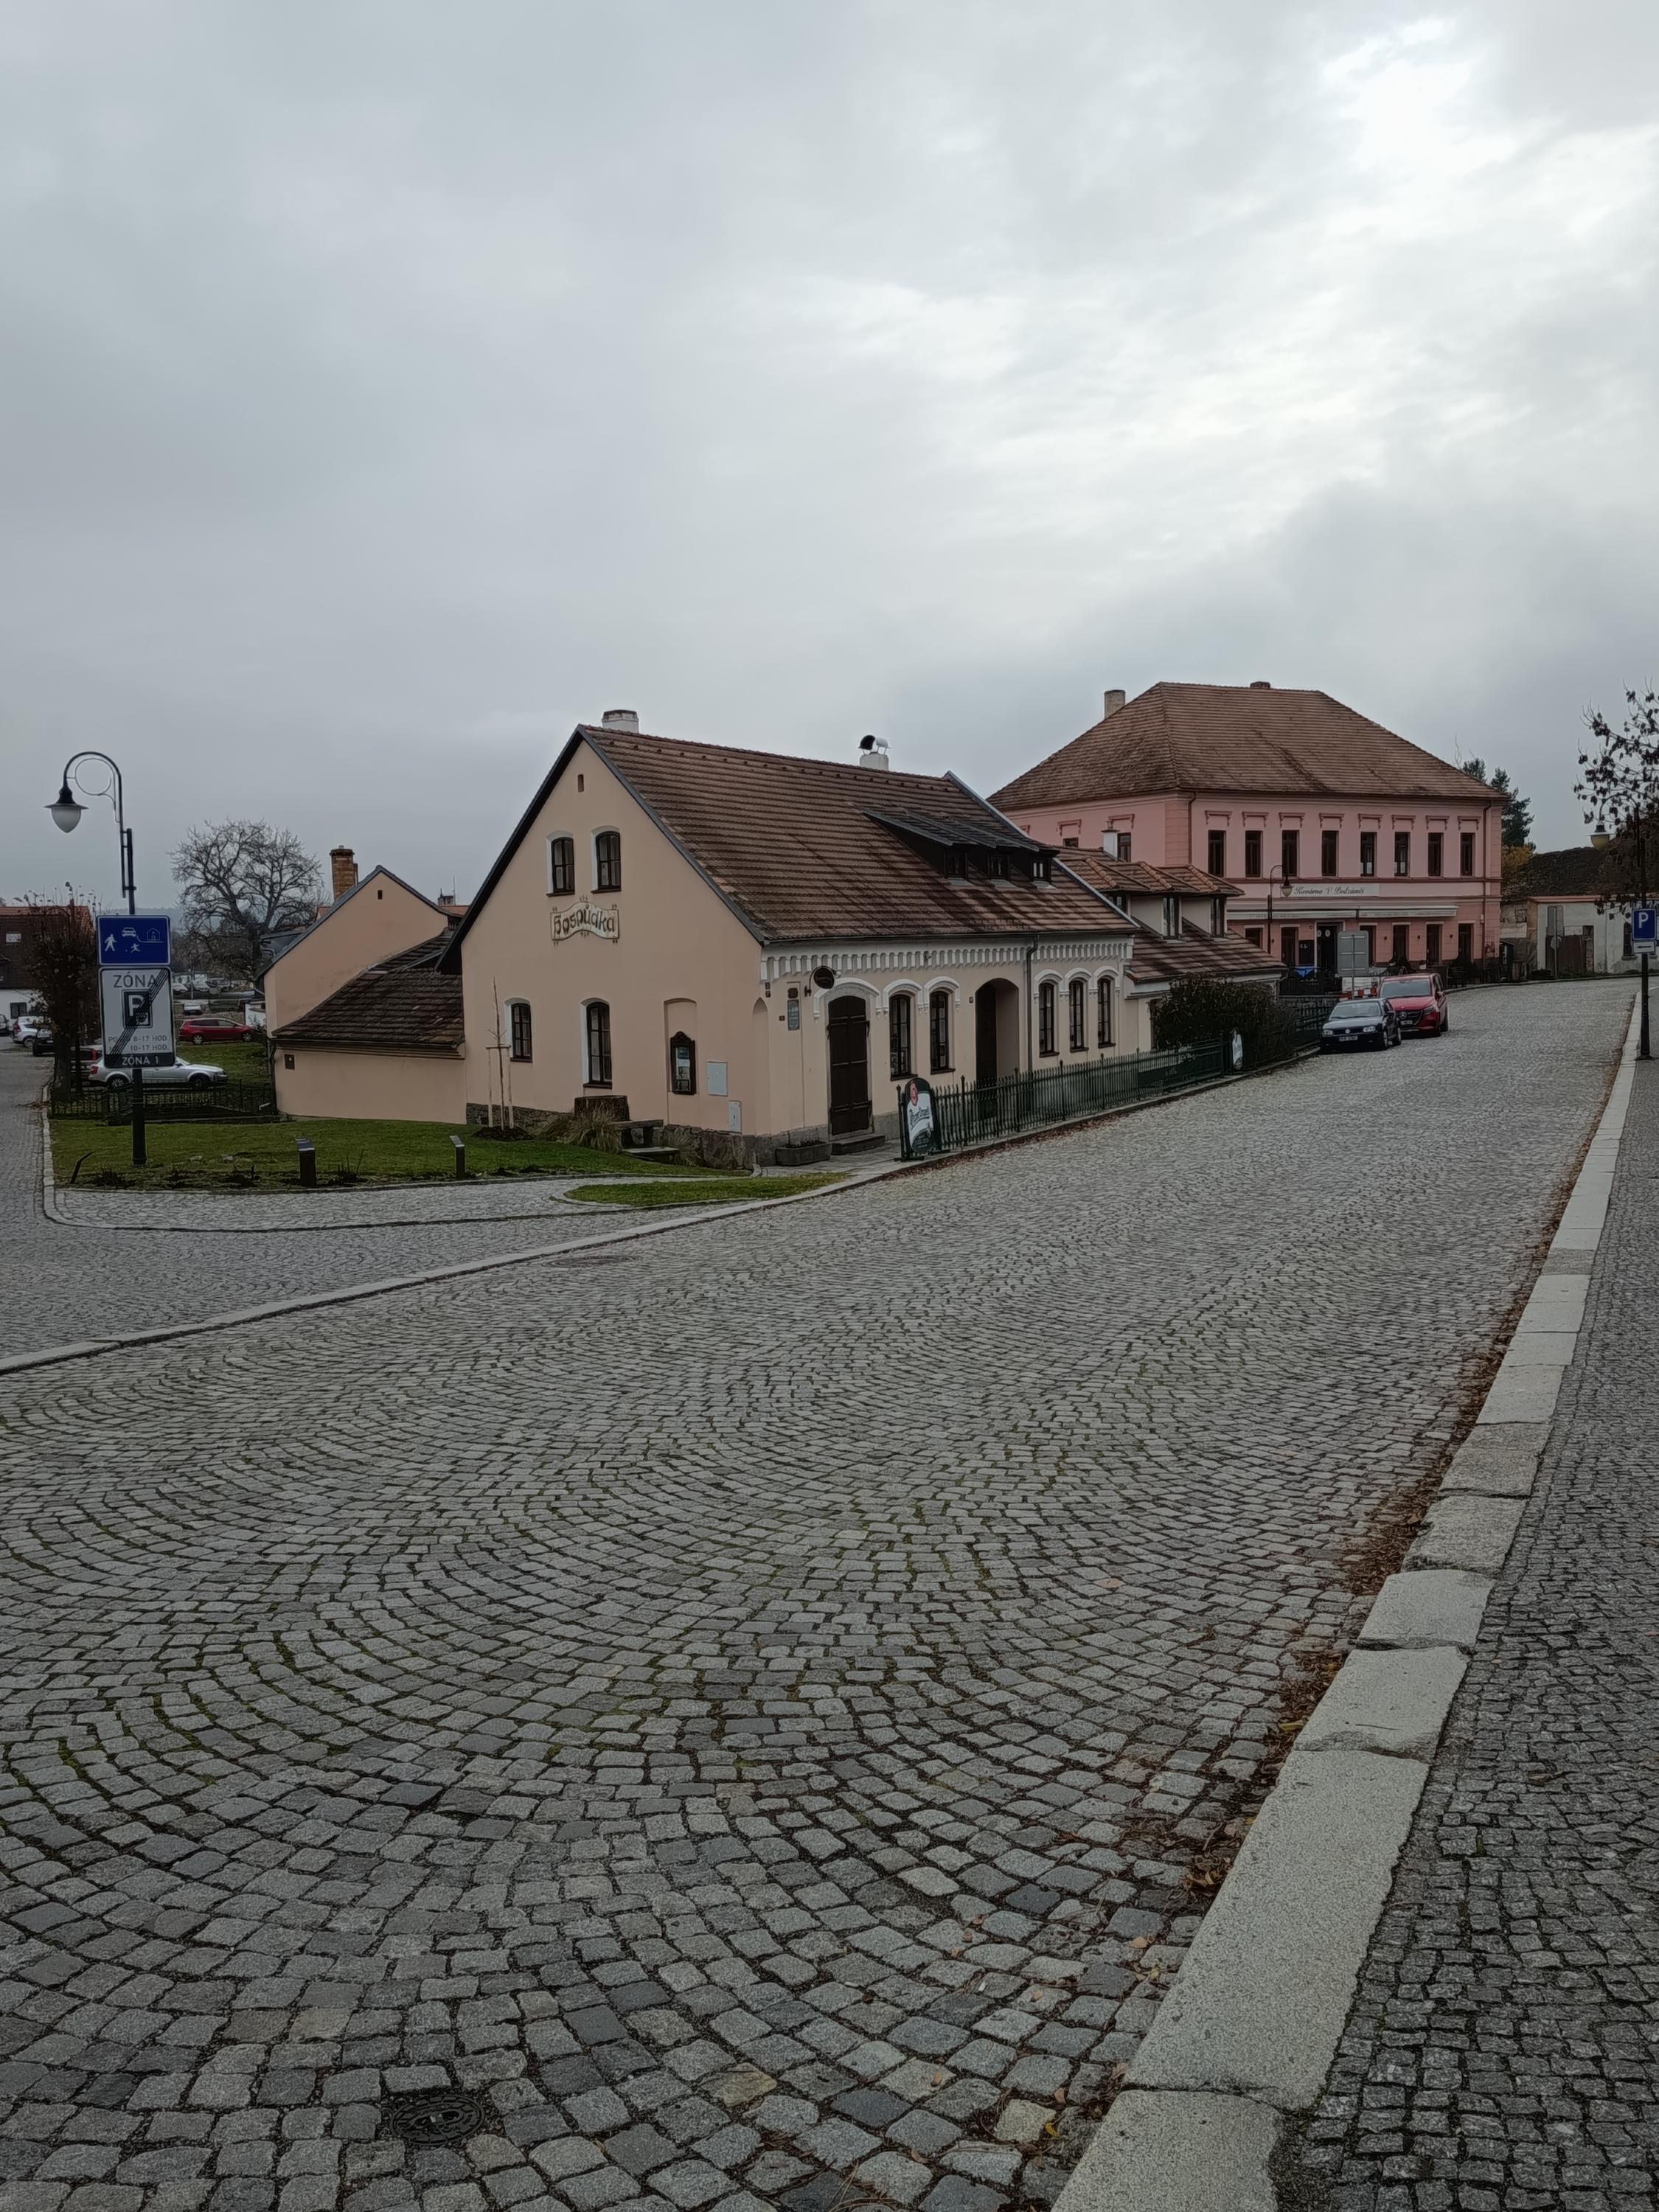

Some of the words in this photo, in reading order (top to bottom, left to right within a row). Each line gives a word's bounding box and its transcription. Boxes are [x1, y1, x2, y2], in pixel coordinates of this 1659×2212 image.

[1638, 912, 1649, 929] P
[113, 971, 158, 988] ZÓNA
[122, 1054, 150, 1065] ZÓNA
[155, 1056, 159, 1065] 1
